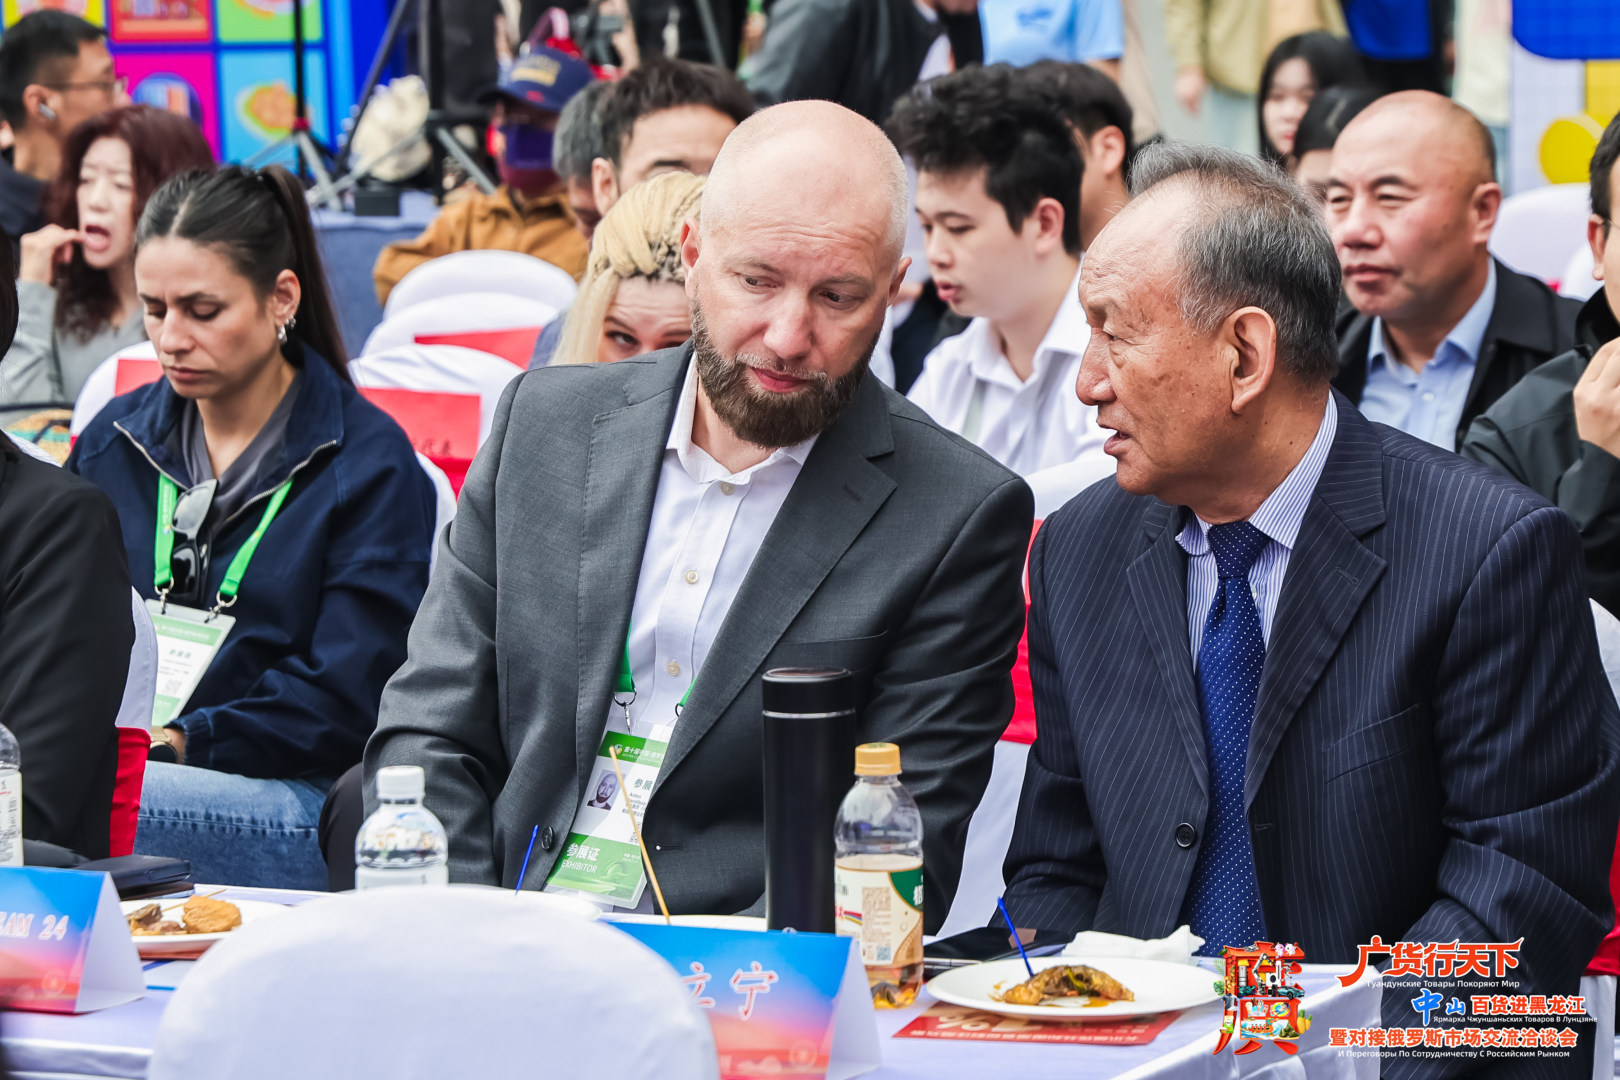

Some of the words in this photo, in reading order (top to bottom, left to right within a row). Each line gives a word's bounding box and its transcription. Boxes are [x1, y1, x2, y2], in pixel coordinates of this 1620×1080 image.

[566, 842, 600, 861] 参展证
[561, 859, 597, 873] EXHIBITOR
[38, 914, 69, 940] 24
